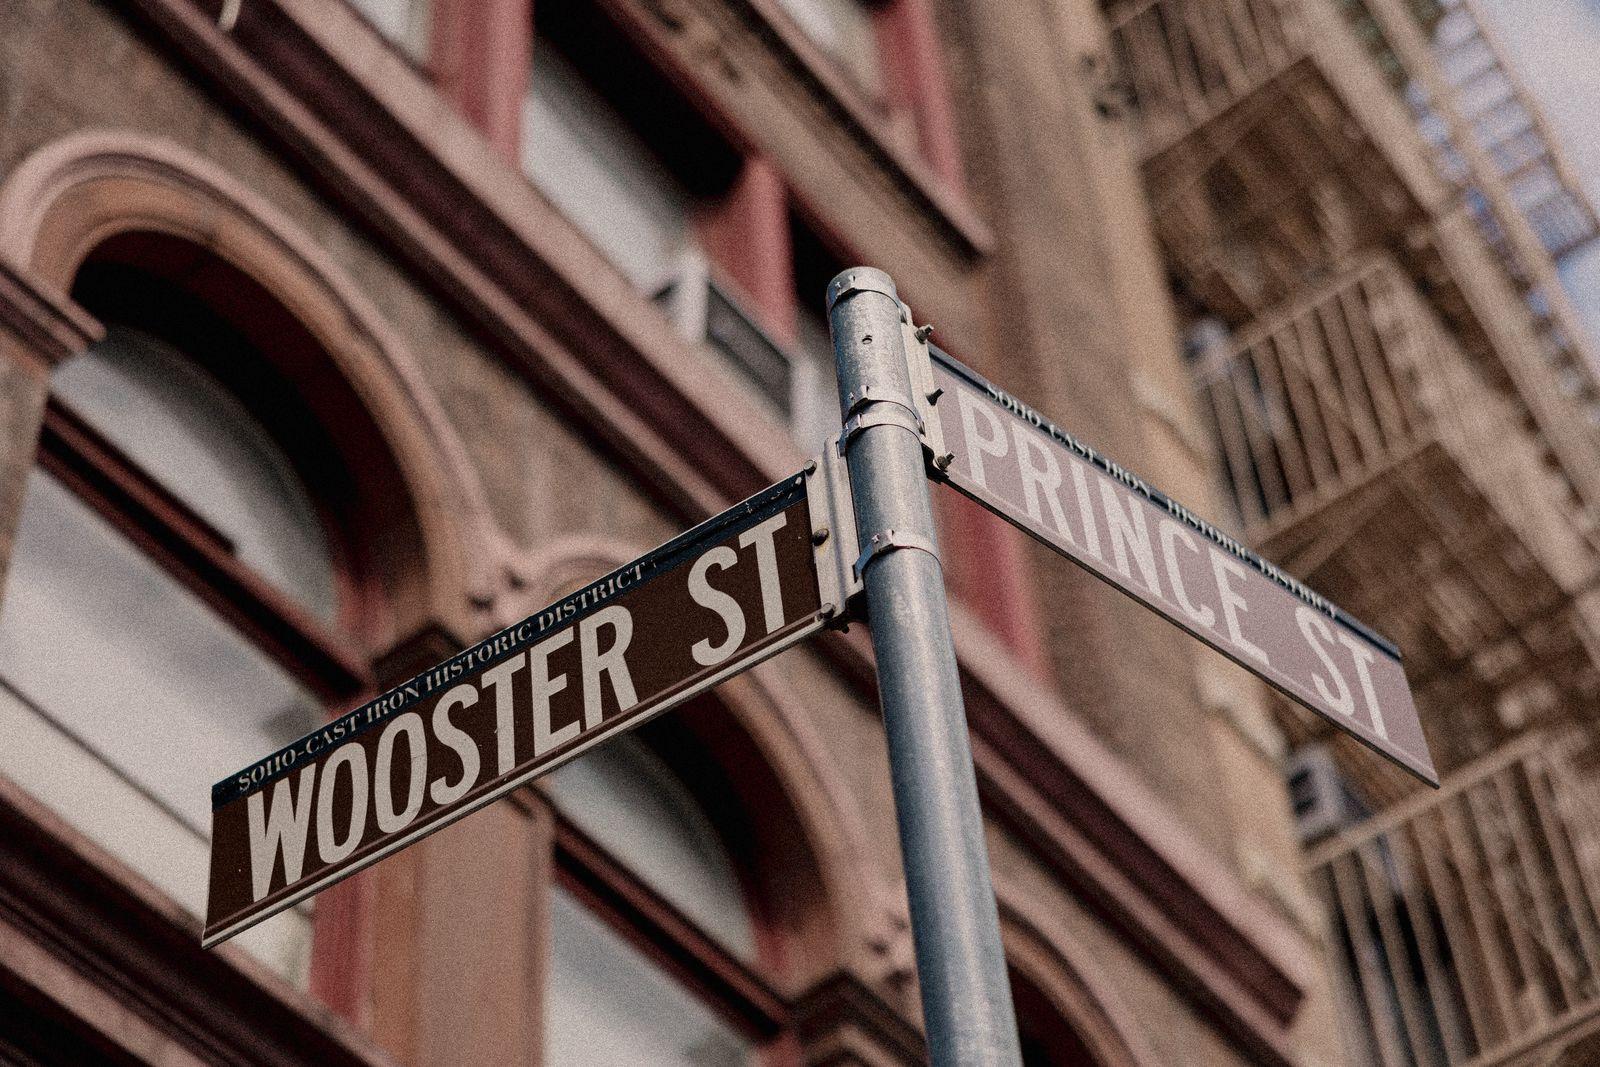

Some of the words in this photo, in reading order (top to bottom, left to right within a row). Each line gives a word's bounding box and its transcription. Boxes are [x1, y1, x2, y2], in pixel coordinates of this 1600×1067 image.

[247, 604, 639, 902] WOOSTER
[687, 511, 787, 666] ST
[367, 681, 420, 724] IRON
[426, 622, 532, 691] HISTORIC
[538, 561, 647, 632] DISTRICT
[955, 385, 1269, 665] PRINCE
[1295, 605, 1388, 739] ST
